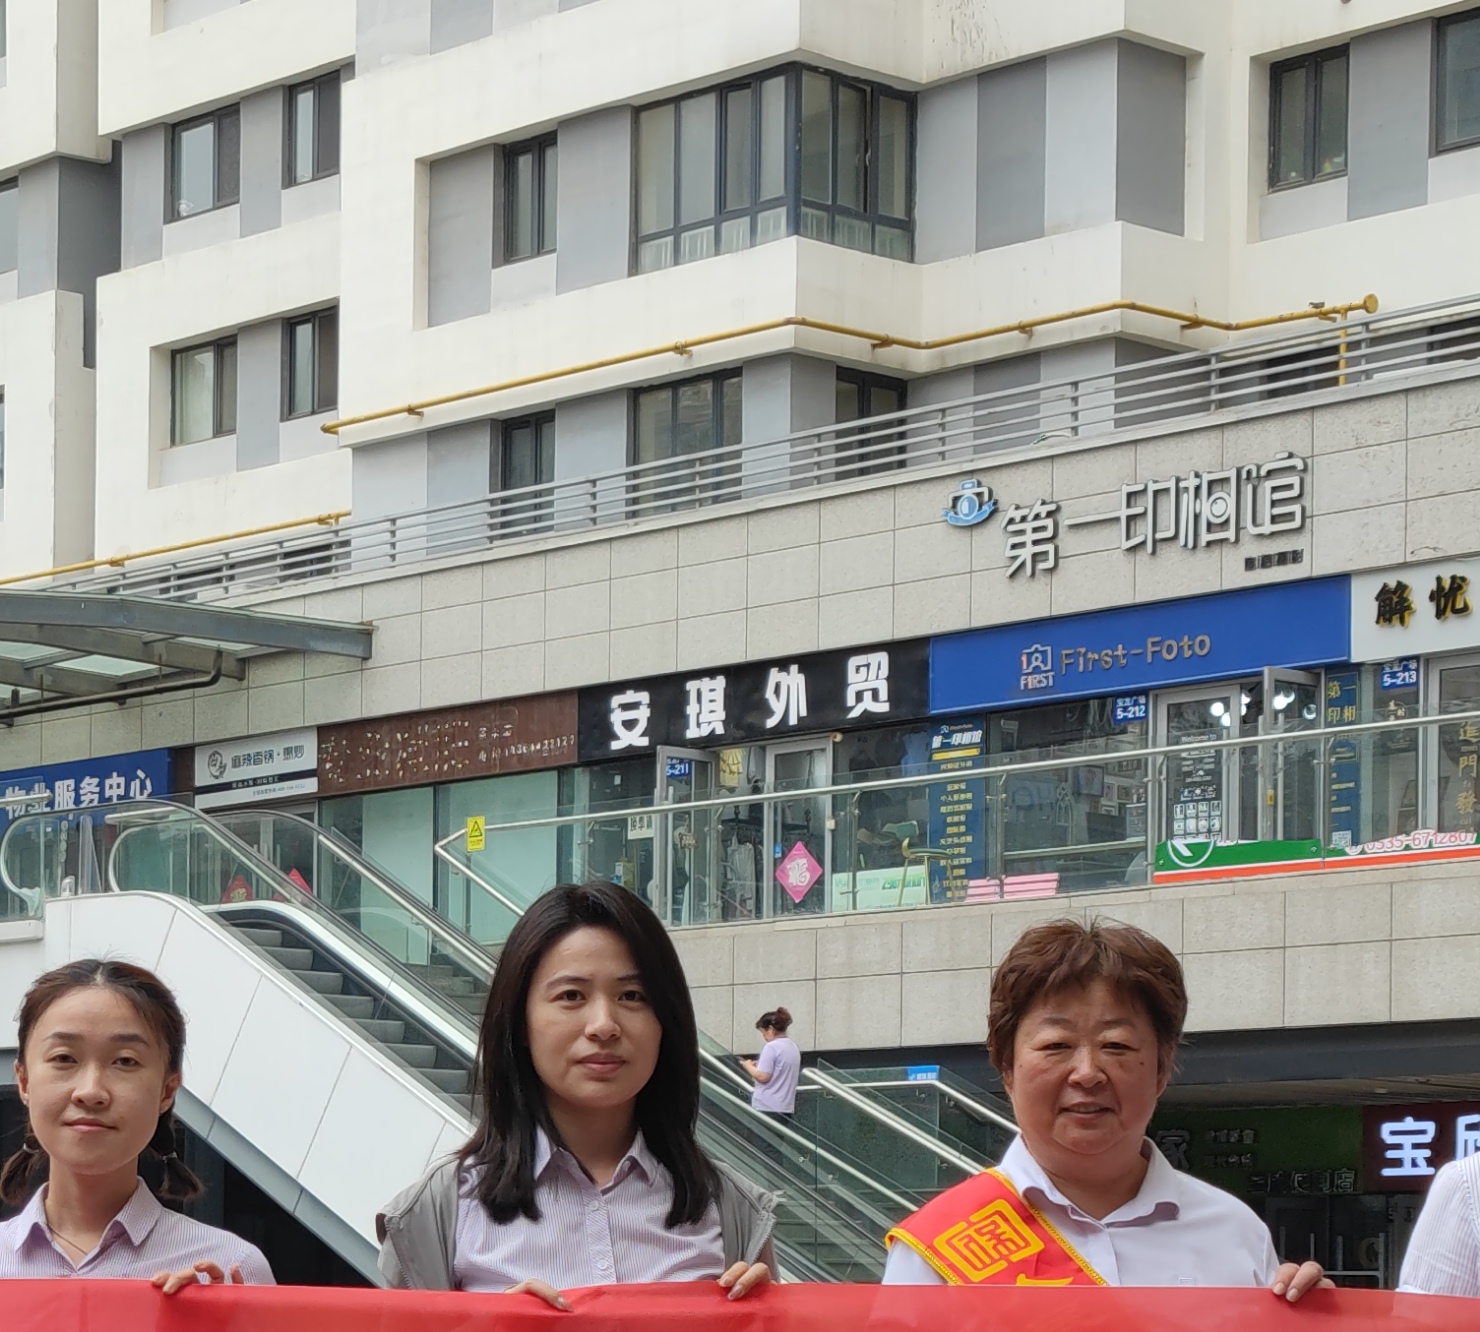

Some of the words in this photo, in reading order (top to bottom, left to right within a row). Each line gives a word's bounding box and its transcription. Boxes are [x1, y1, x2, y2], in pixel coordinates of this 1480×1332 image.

[1000, 451, 1308, 579] 第一印相馆
[1060, 633, 1212, 675] First-Foto
[1019, 671, 1055, 691] FIRST
[1382, 670, 1417, 687] 5-213
[610, 651, 890, 750] 安琪外贸
[1116, 704, 1146, 720] 5-212
[665, 762, 689, 776] 5-211
[5, 768, 153, 821] 物业服务中心
